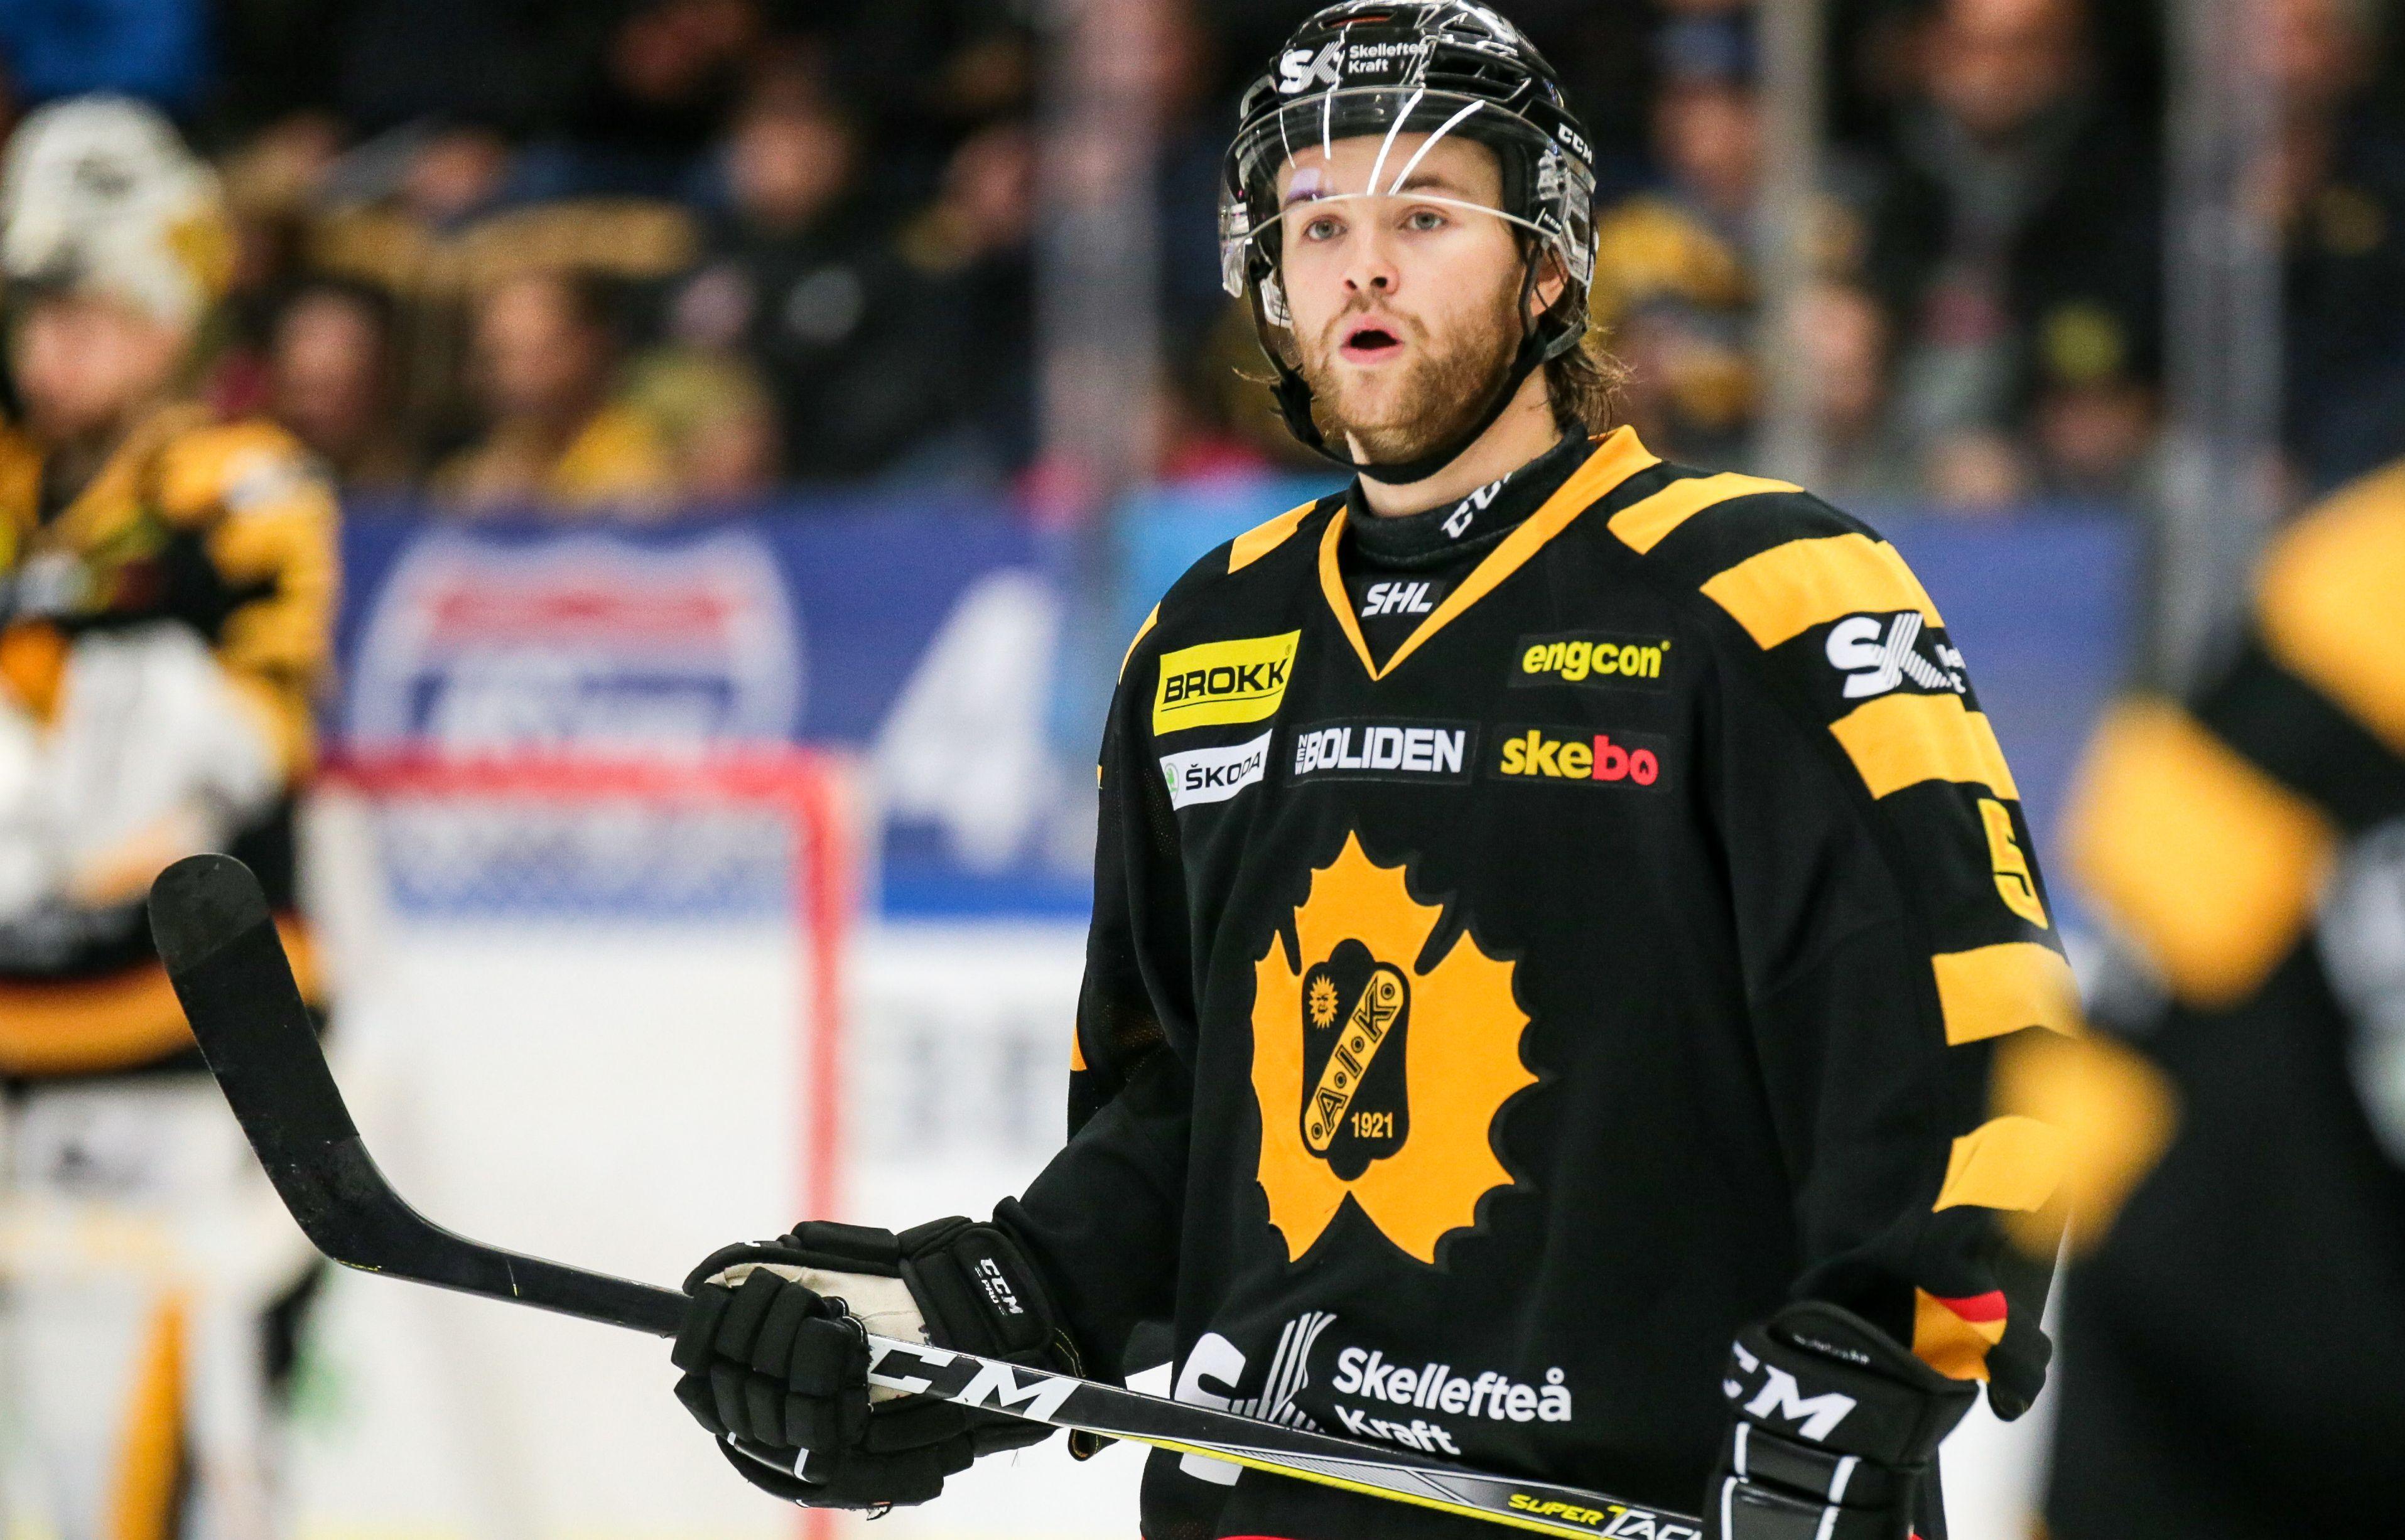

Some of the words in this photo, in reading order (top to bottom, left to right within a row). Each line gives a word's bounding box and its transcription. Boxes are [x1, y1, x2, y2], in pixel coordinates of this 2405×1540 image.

[1348, 58, 1388, 74] Kraft
[1558, 122, 1592, 164] CCM
[1440, 471, 1513, 539] CC
[1361, 582, 1432, 617] SHL
[1163, 658, 1289, 704] BROKK
[1522, 640, 1662, 682] engcon
[1186, 751, 1262, 790] ŠKODA
[1302, 727, 1466, 773] BOLIDEN
[1500, 730, 1659, 785] skebo
[1977, 797, 2050, 930] 5
[1351, 1111, 1394, 1138] 1921
[980, 1257, 1024, 1314] CCM
[1332, 1347, 1572, 1422] Skellefteå
[1334, 1404, 1462, 1455] Kraft
[1508, 1494, 1604, 1526] SUPER
[1601, 1509, 1702, 1540] TAC
